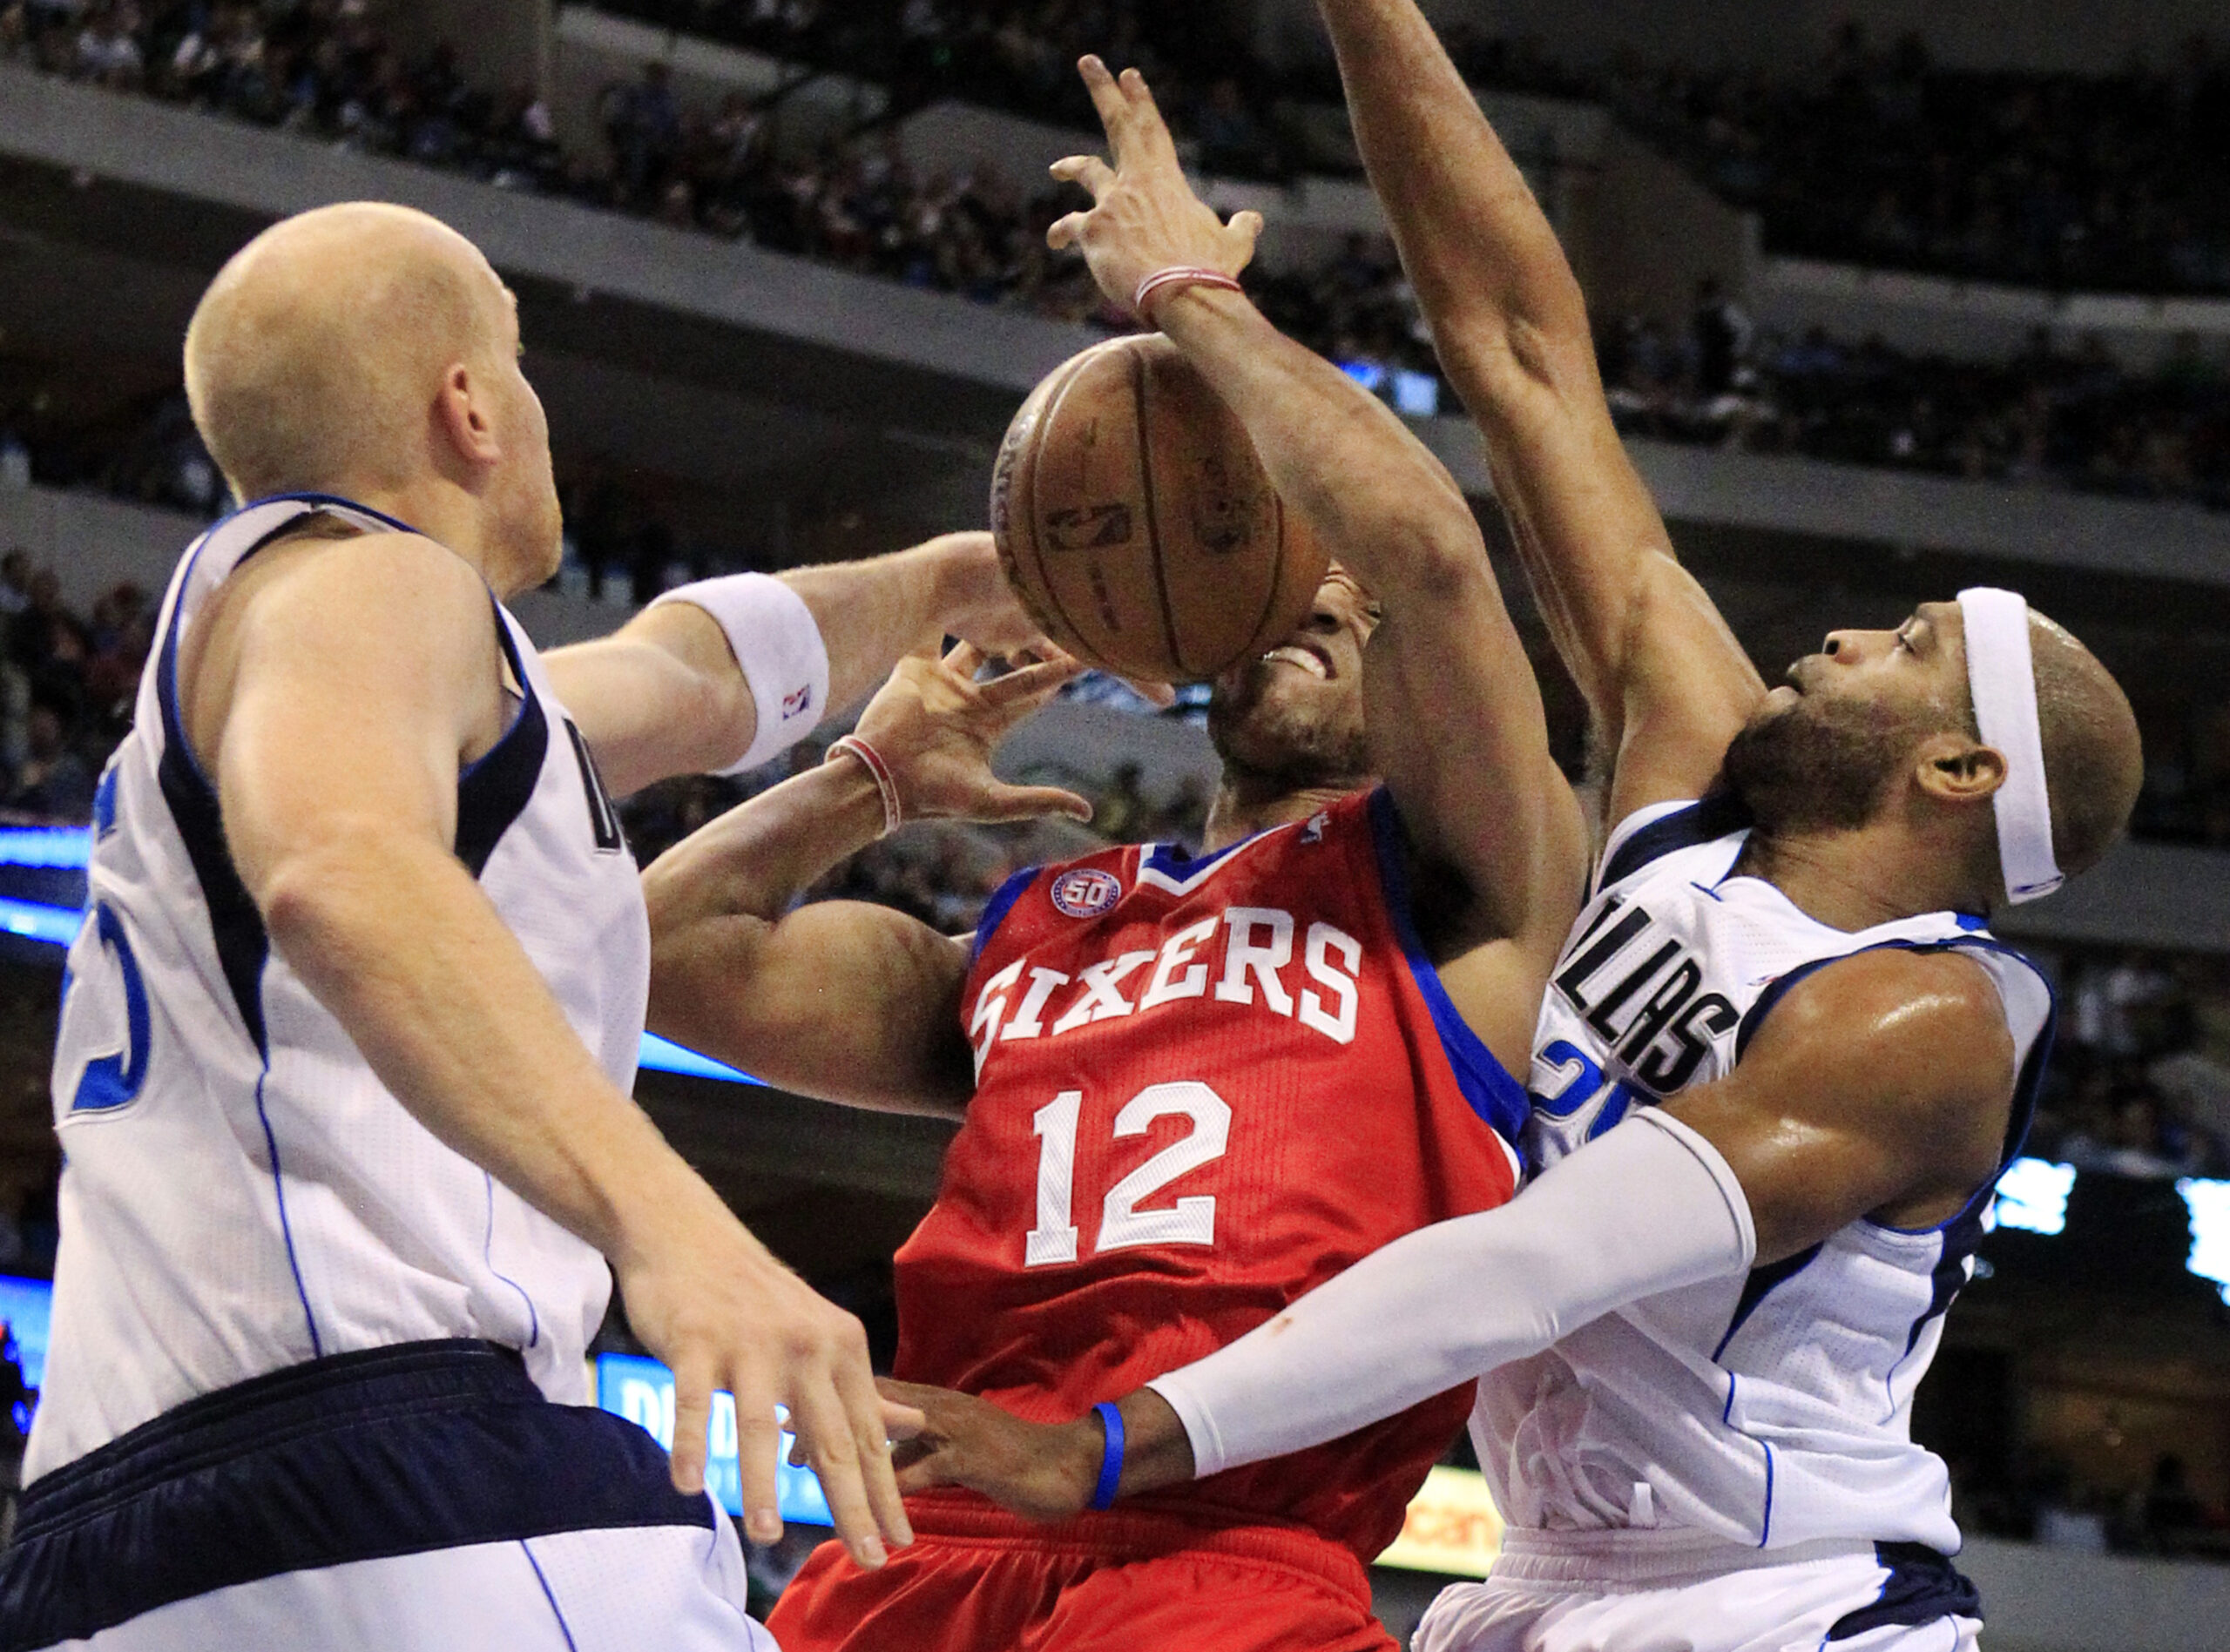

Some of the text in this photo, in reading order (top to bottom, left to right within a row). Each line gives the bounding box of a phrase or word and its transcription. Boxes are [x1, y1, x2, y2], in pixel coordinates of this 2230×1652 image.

[1064, 880, 1109, 907] 50
[970, 906, 1362, 1089] SIXERS
[1024, 1080, 1233, 1267] 12
